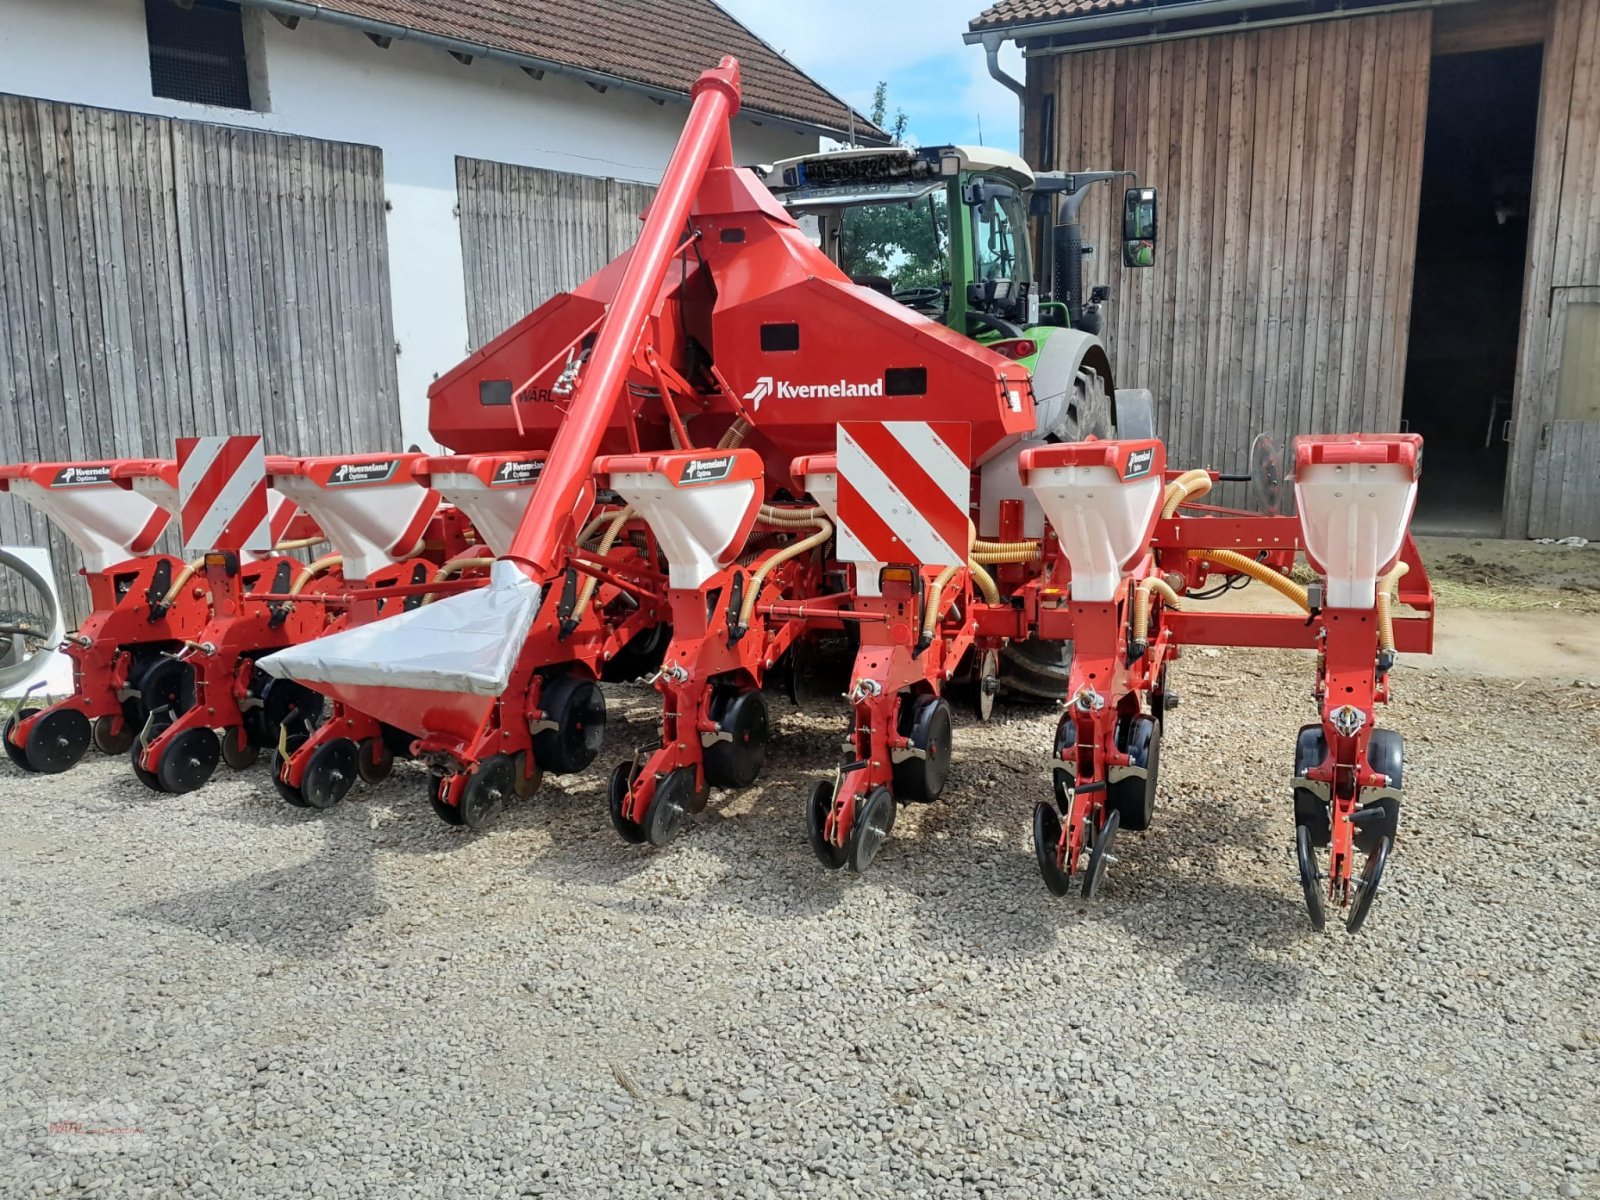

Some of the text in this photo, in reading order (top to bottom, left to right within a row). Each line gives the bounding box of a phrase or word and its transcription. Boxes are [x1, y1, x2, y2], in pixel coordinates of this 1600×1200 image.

[777, 378, 883, 399] Kverneland
[348, 462, 388, 473] Kverneland
[512, 461, 545, 471] Kvernelan
[75, 467, 110, 476] Kvernela
